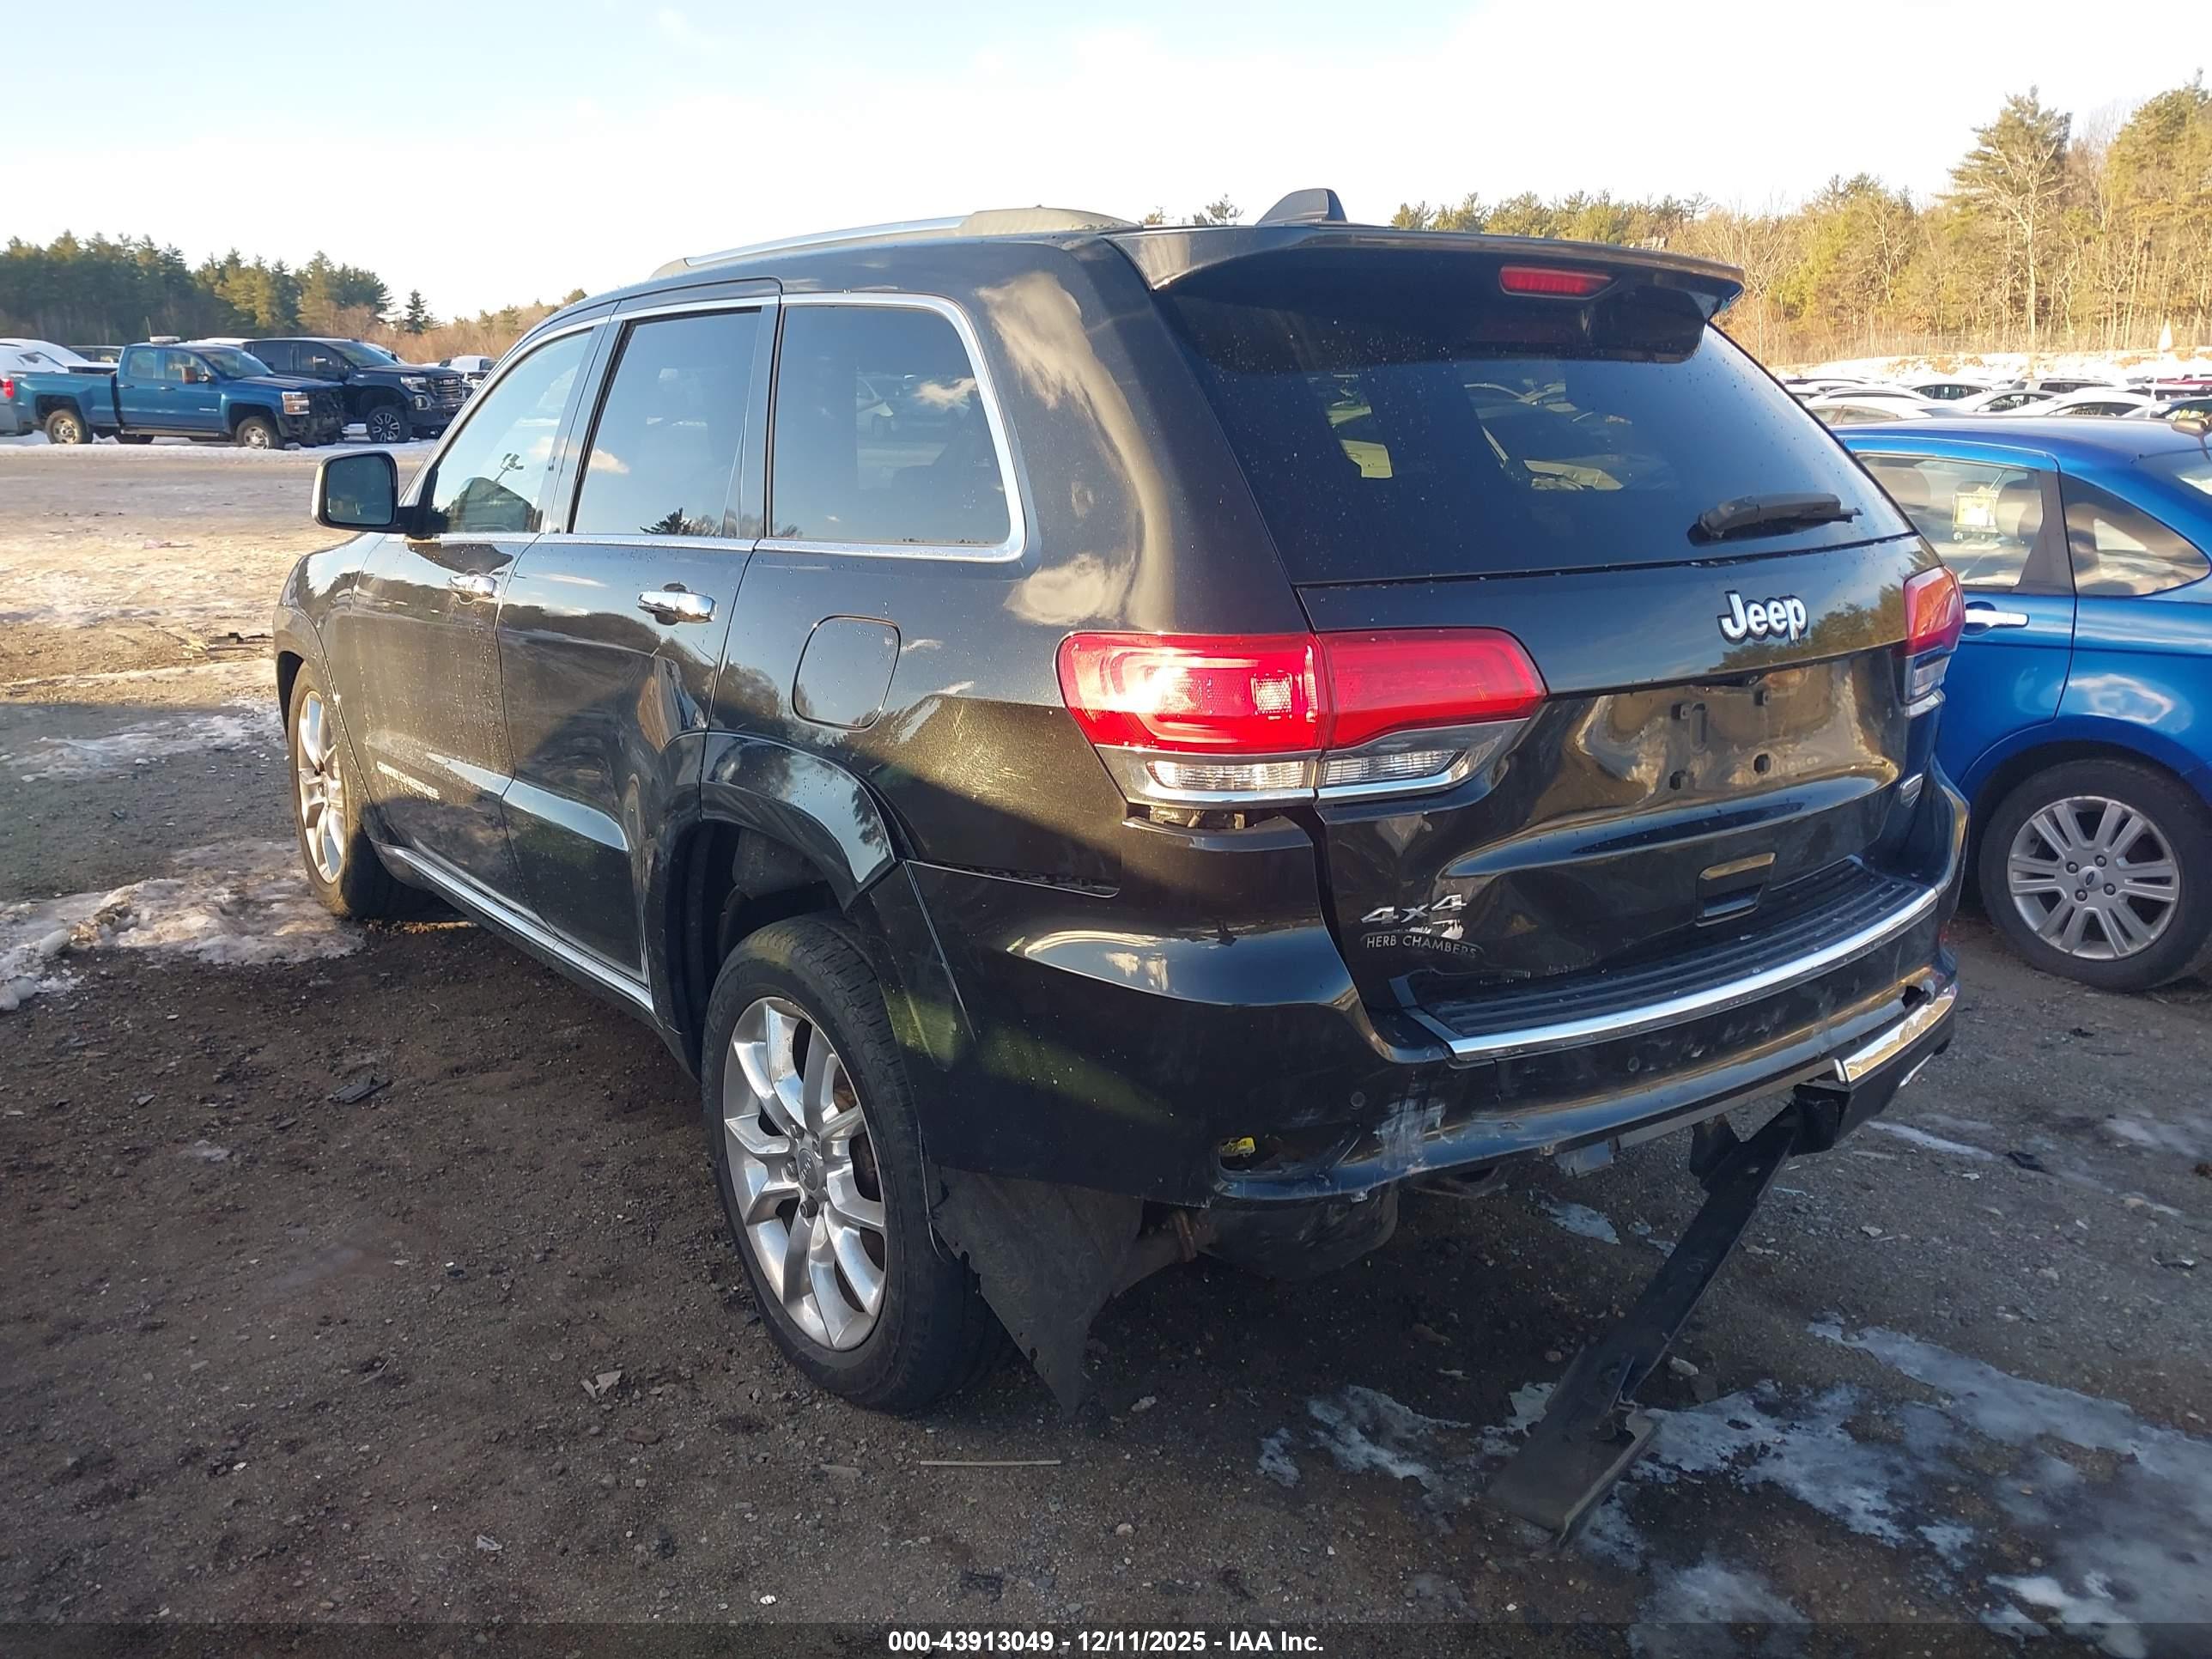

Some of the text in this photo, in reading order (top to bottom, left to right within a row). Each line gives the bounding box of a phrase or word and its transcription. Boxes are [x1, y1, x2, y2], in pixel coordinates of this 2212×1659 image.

[1718, 591, 1808, 643] Jeep
[1366, 935, 1477, 958] HERB CHAMBERS
